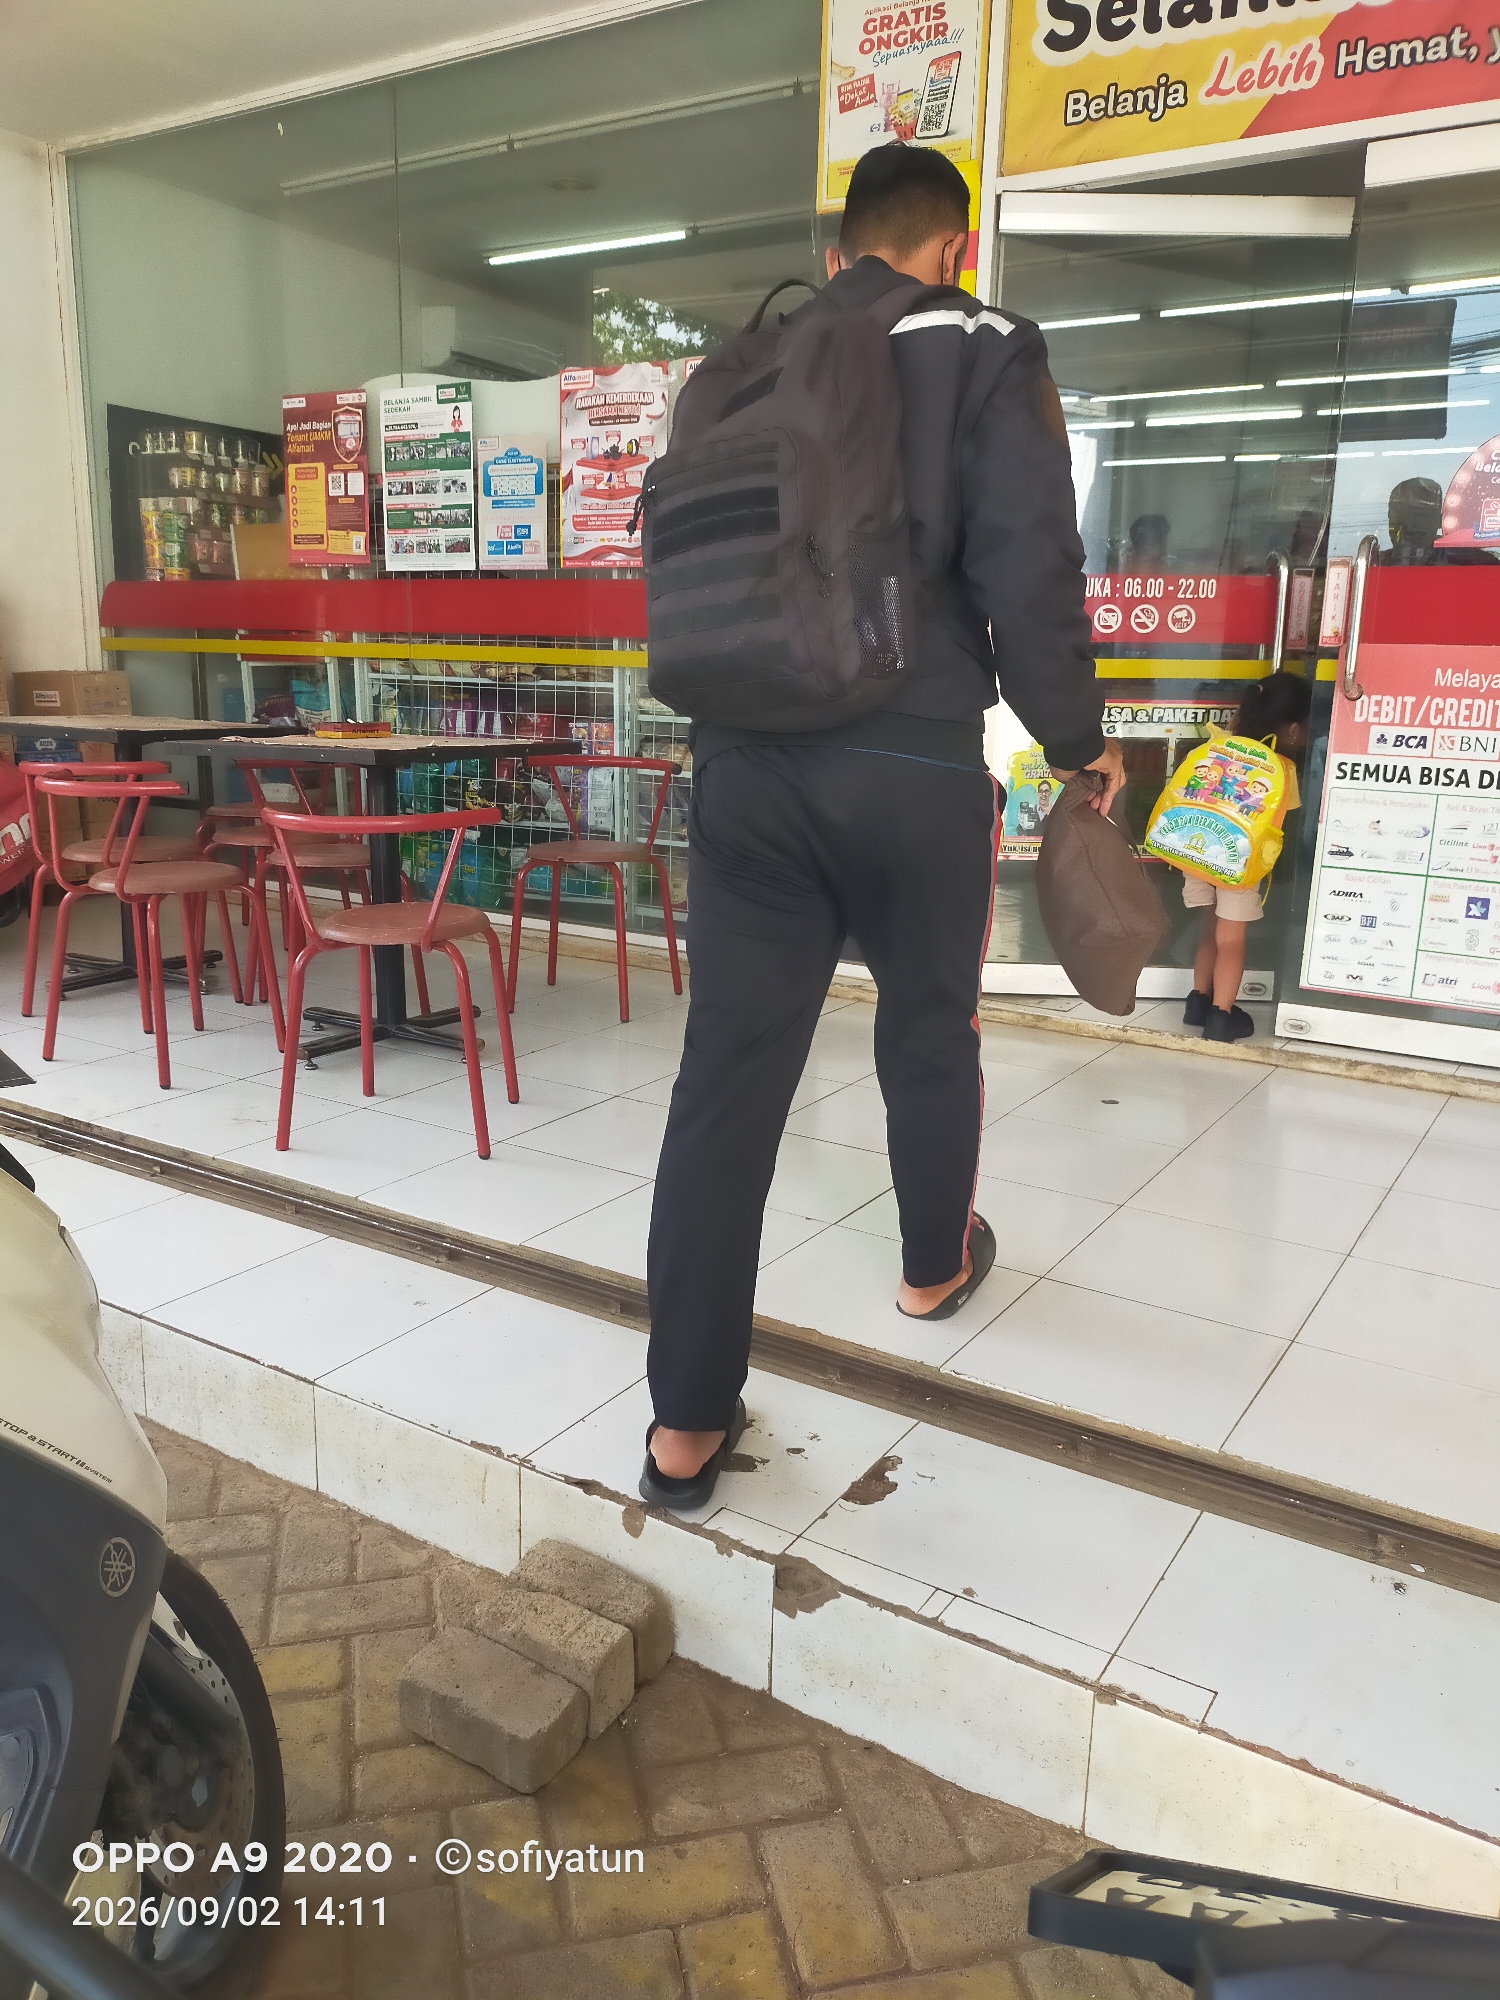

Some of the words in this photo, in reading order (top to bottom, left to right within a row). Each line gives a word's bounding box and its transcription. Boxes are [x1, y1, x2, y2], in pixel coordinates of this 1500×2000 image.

[862, 2, 946, 35] GRATIS
[858, 21, 949, 55] ONGKIR
[1064, 72, 1187, 125] Belanja
[1204, 42, 1317, 98] Lebih
[1335, 25, 1480, 79] Hemat,
[563, 373, 591, 382] Alfamart
[286, 423, 299, 433] Ayo!
[299, 422, 311, 430] Jadi
[312, 421, 331, 431] Bagian
[287, 432, 308, 442] Tenant
[310, 431, 331, 440] UMKM
[287, 443, 314, 453] Alfamart
[1086, 578, 1111, 598] UKA
[1124, 578, 1164, 598] 06.00
[1177, 579, 1217, 599] 22.00
[1101, 707, 1133, 722] LSA
[1136, 709, 1149, 722] &
[1152, 707, 1206, 722] PAKET
[1392, 734, 1428, 750] BCA
[1459, 735, 1497, 753] BNI
[1335, 761, 1412, 786] SEMUA
[1419, 766, 1471, 788] BISA
[1478, 769, 1500, 791] D
[1002, 845, 1019, 854] Yuk,
[1020, 845, 1031, 853] isi
[1328, 889, 1364, 899] ADIRA
[1360, 915, 1377, 928] BFI
